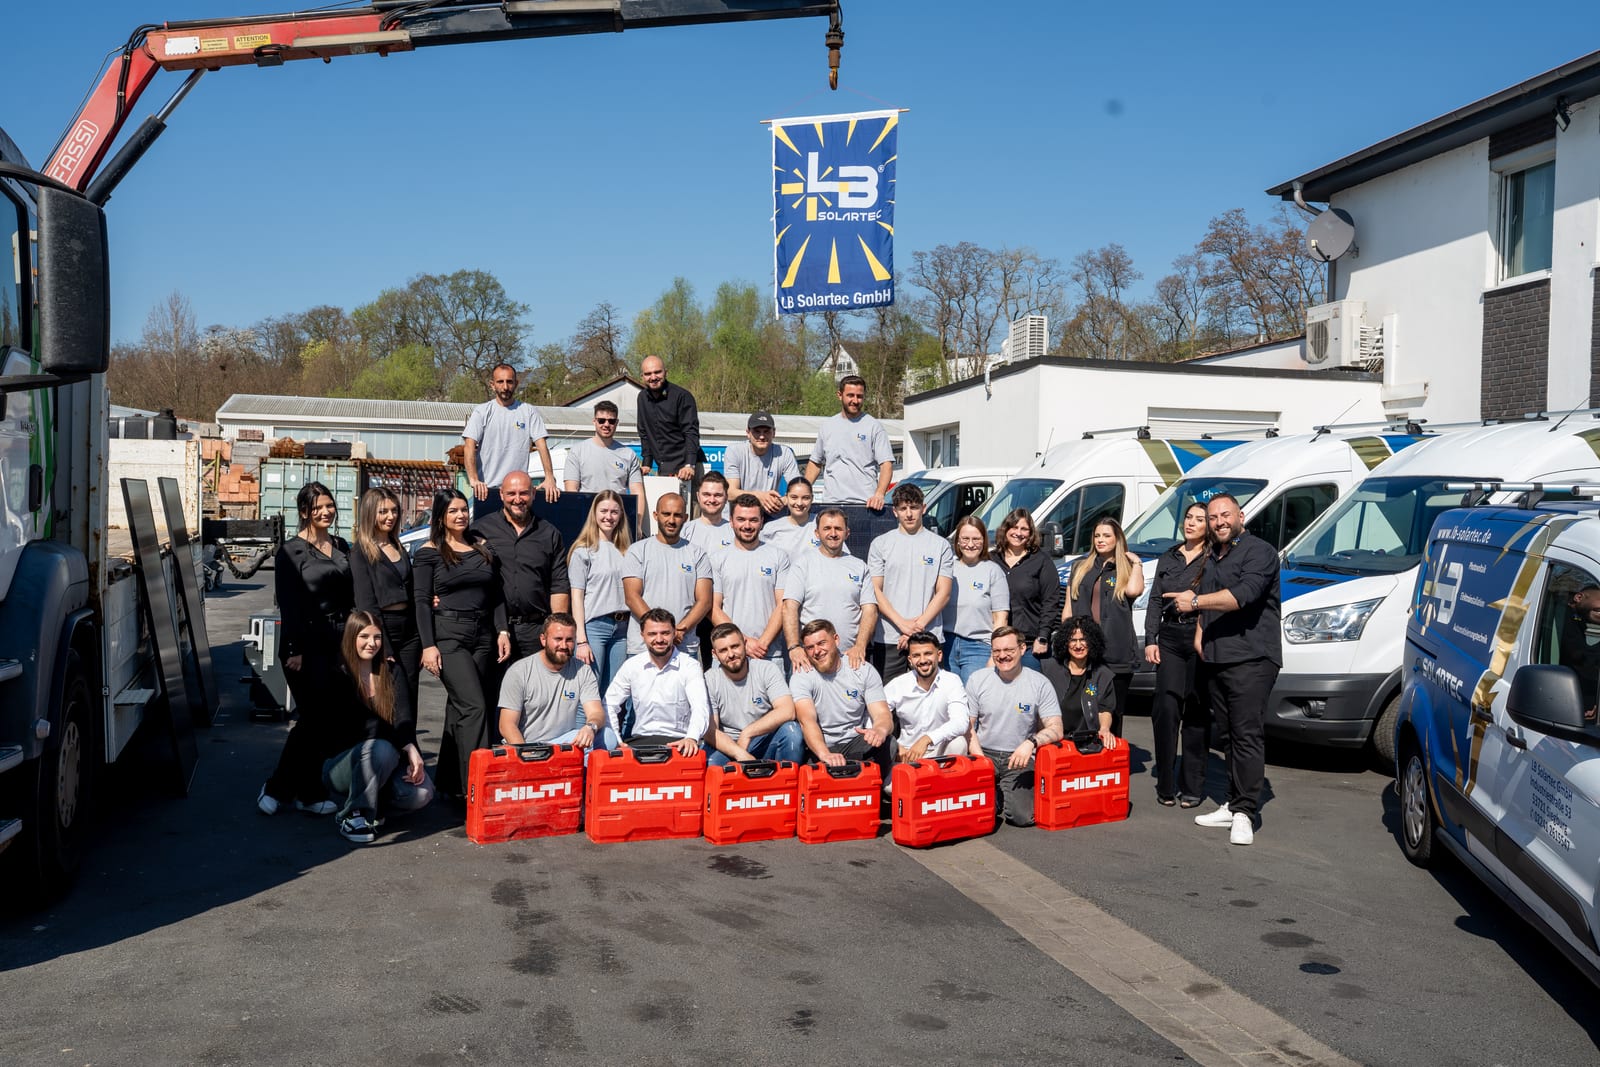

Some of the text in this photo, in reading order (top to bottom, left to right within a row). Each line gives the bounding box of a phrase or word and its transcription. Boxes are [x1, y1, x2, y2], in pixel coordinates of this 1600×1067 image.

[52, 124, 95, 183] FASSI
[817, 209, 882, 221] SOLARTEC
[781, 289, 891, 309] LB Solartec GmbH
[1437, 525, 1492, 543] www.lb-solartec.de
[495, 782, 571, 802] HILTI
[1061, 772, 1121, 793] HILTI
[1556, 781, 1573, 802] GmbH
[610, 785, 692, 803] HILTI
[726, 794, 790, 810] HILTI
[816, 795, 872, 809] HILTI
[921, 792, 986, 815] HILTI
